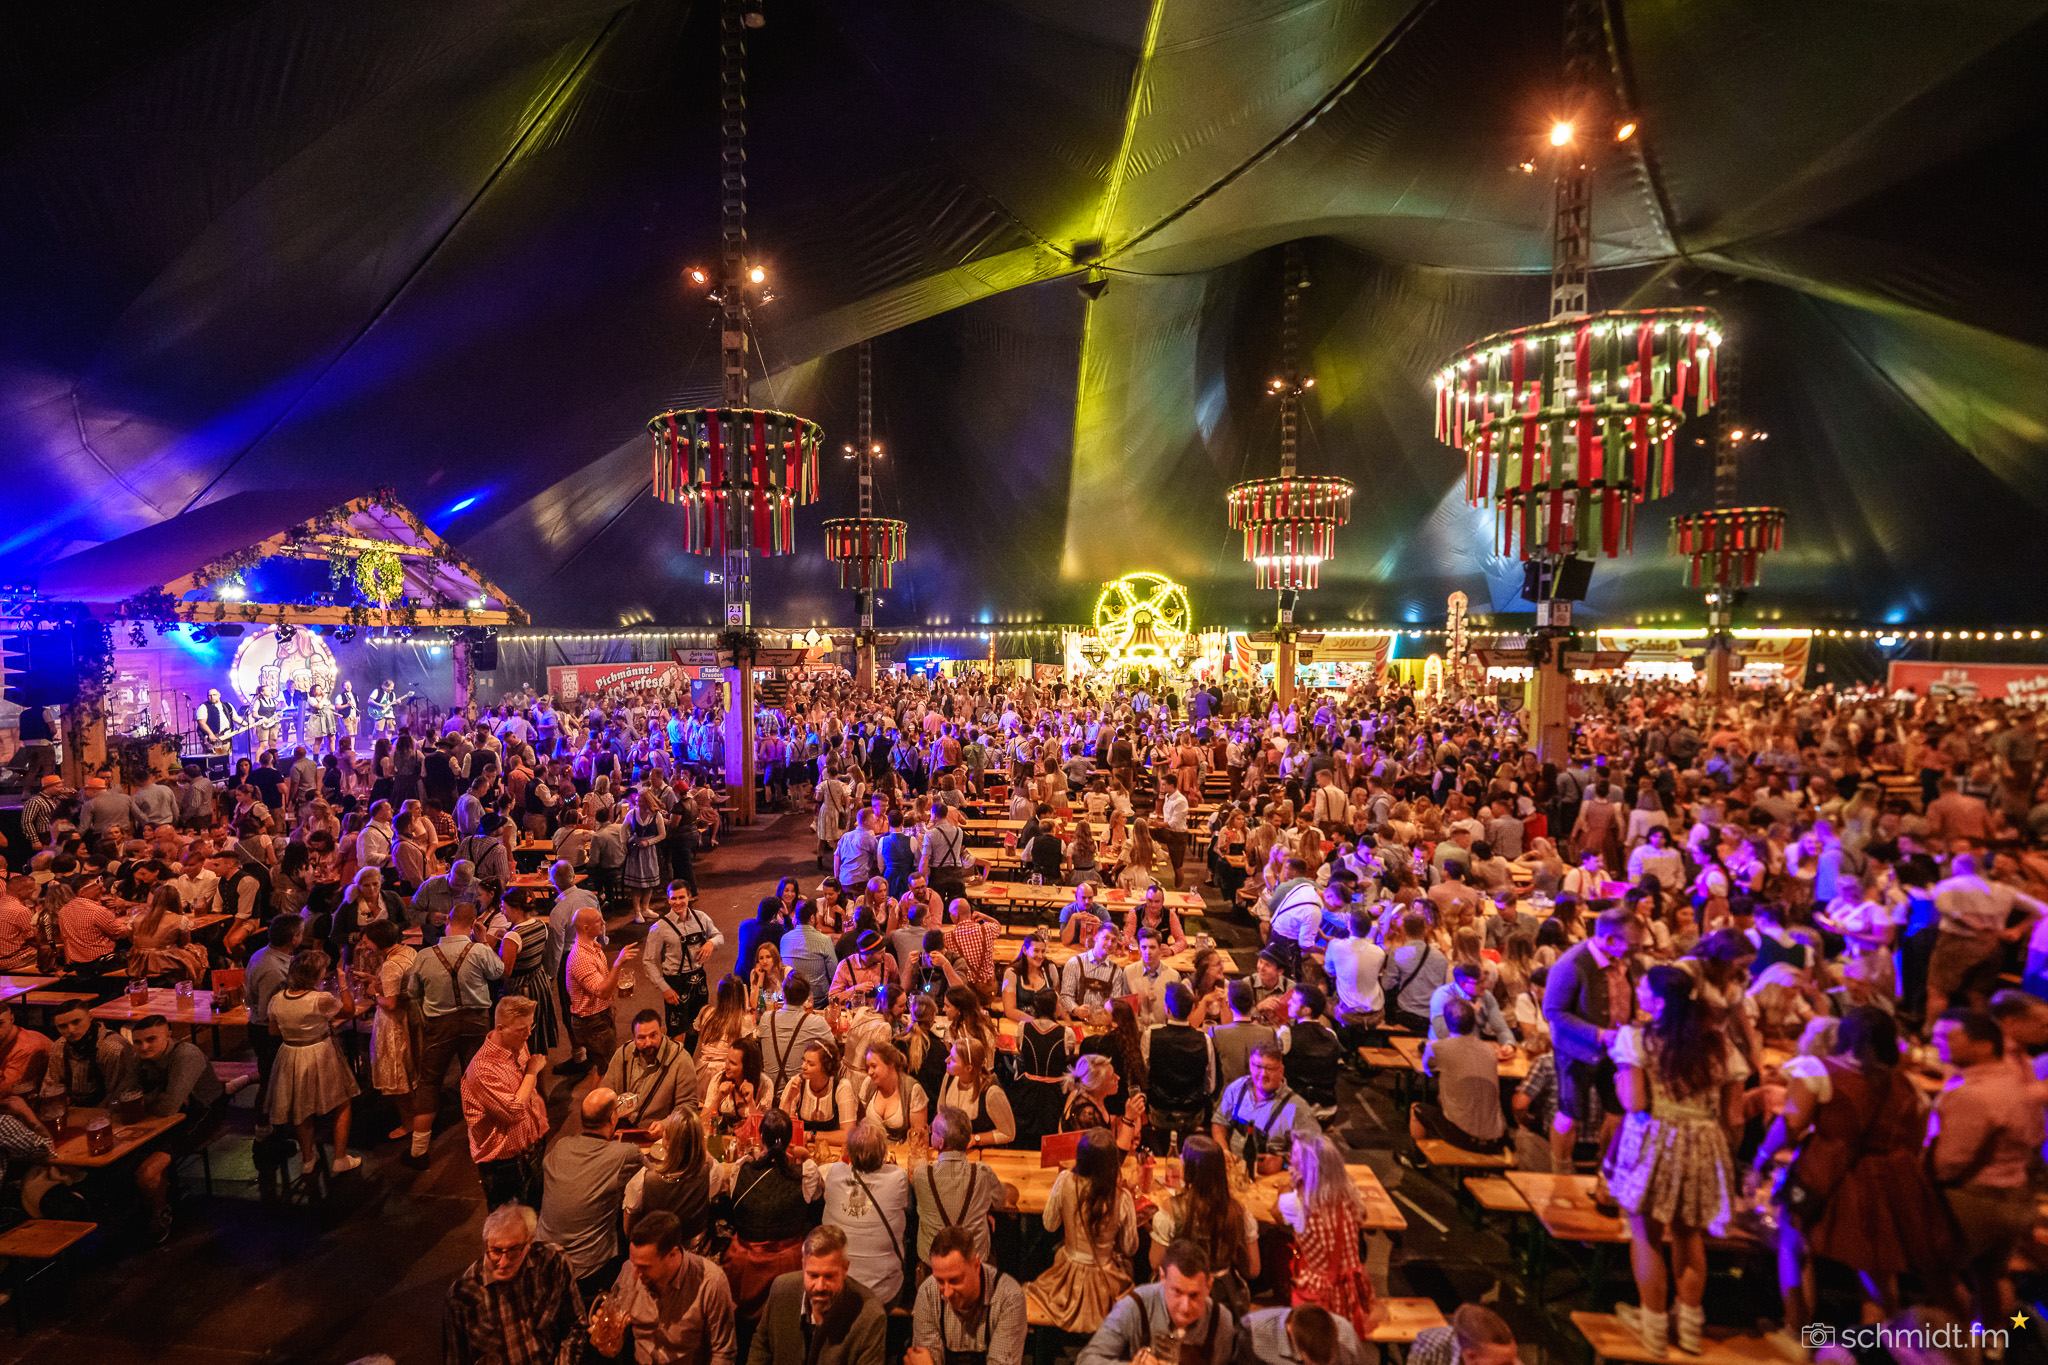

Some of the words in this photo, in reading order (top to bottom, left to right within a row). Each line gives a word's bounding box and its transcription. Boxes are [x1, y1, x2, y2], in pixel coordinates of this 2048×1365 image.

[729, 605, 742, 613] 2.1
[1332, 637, 1368, 649] Sport
[562, 674, 577, 683] MOR
[562, 682, 578, 691] GEN
[562, 691, 578, 699] POST
